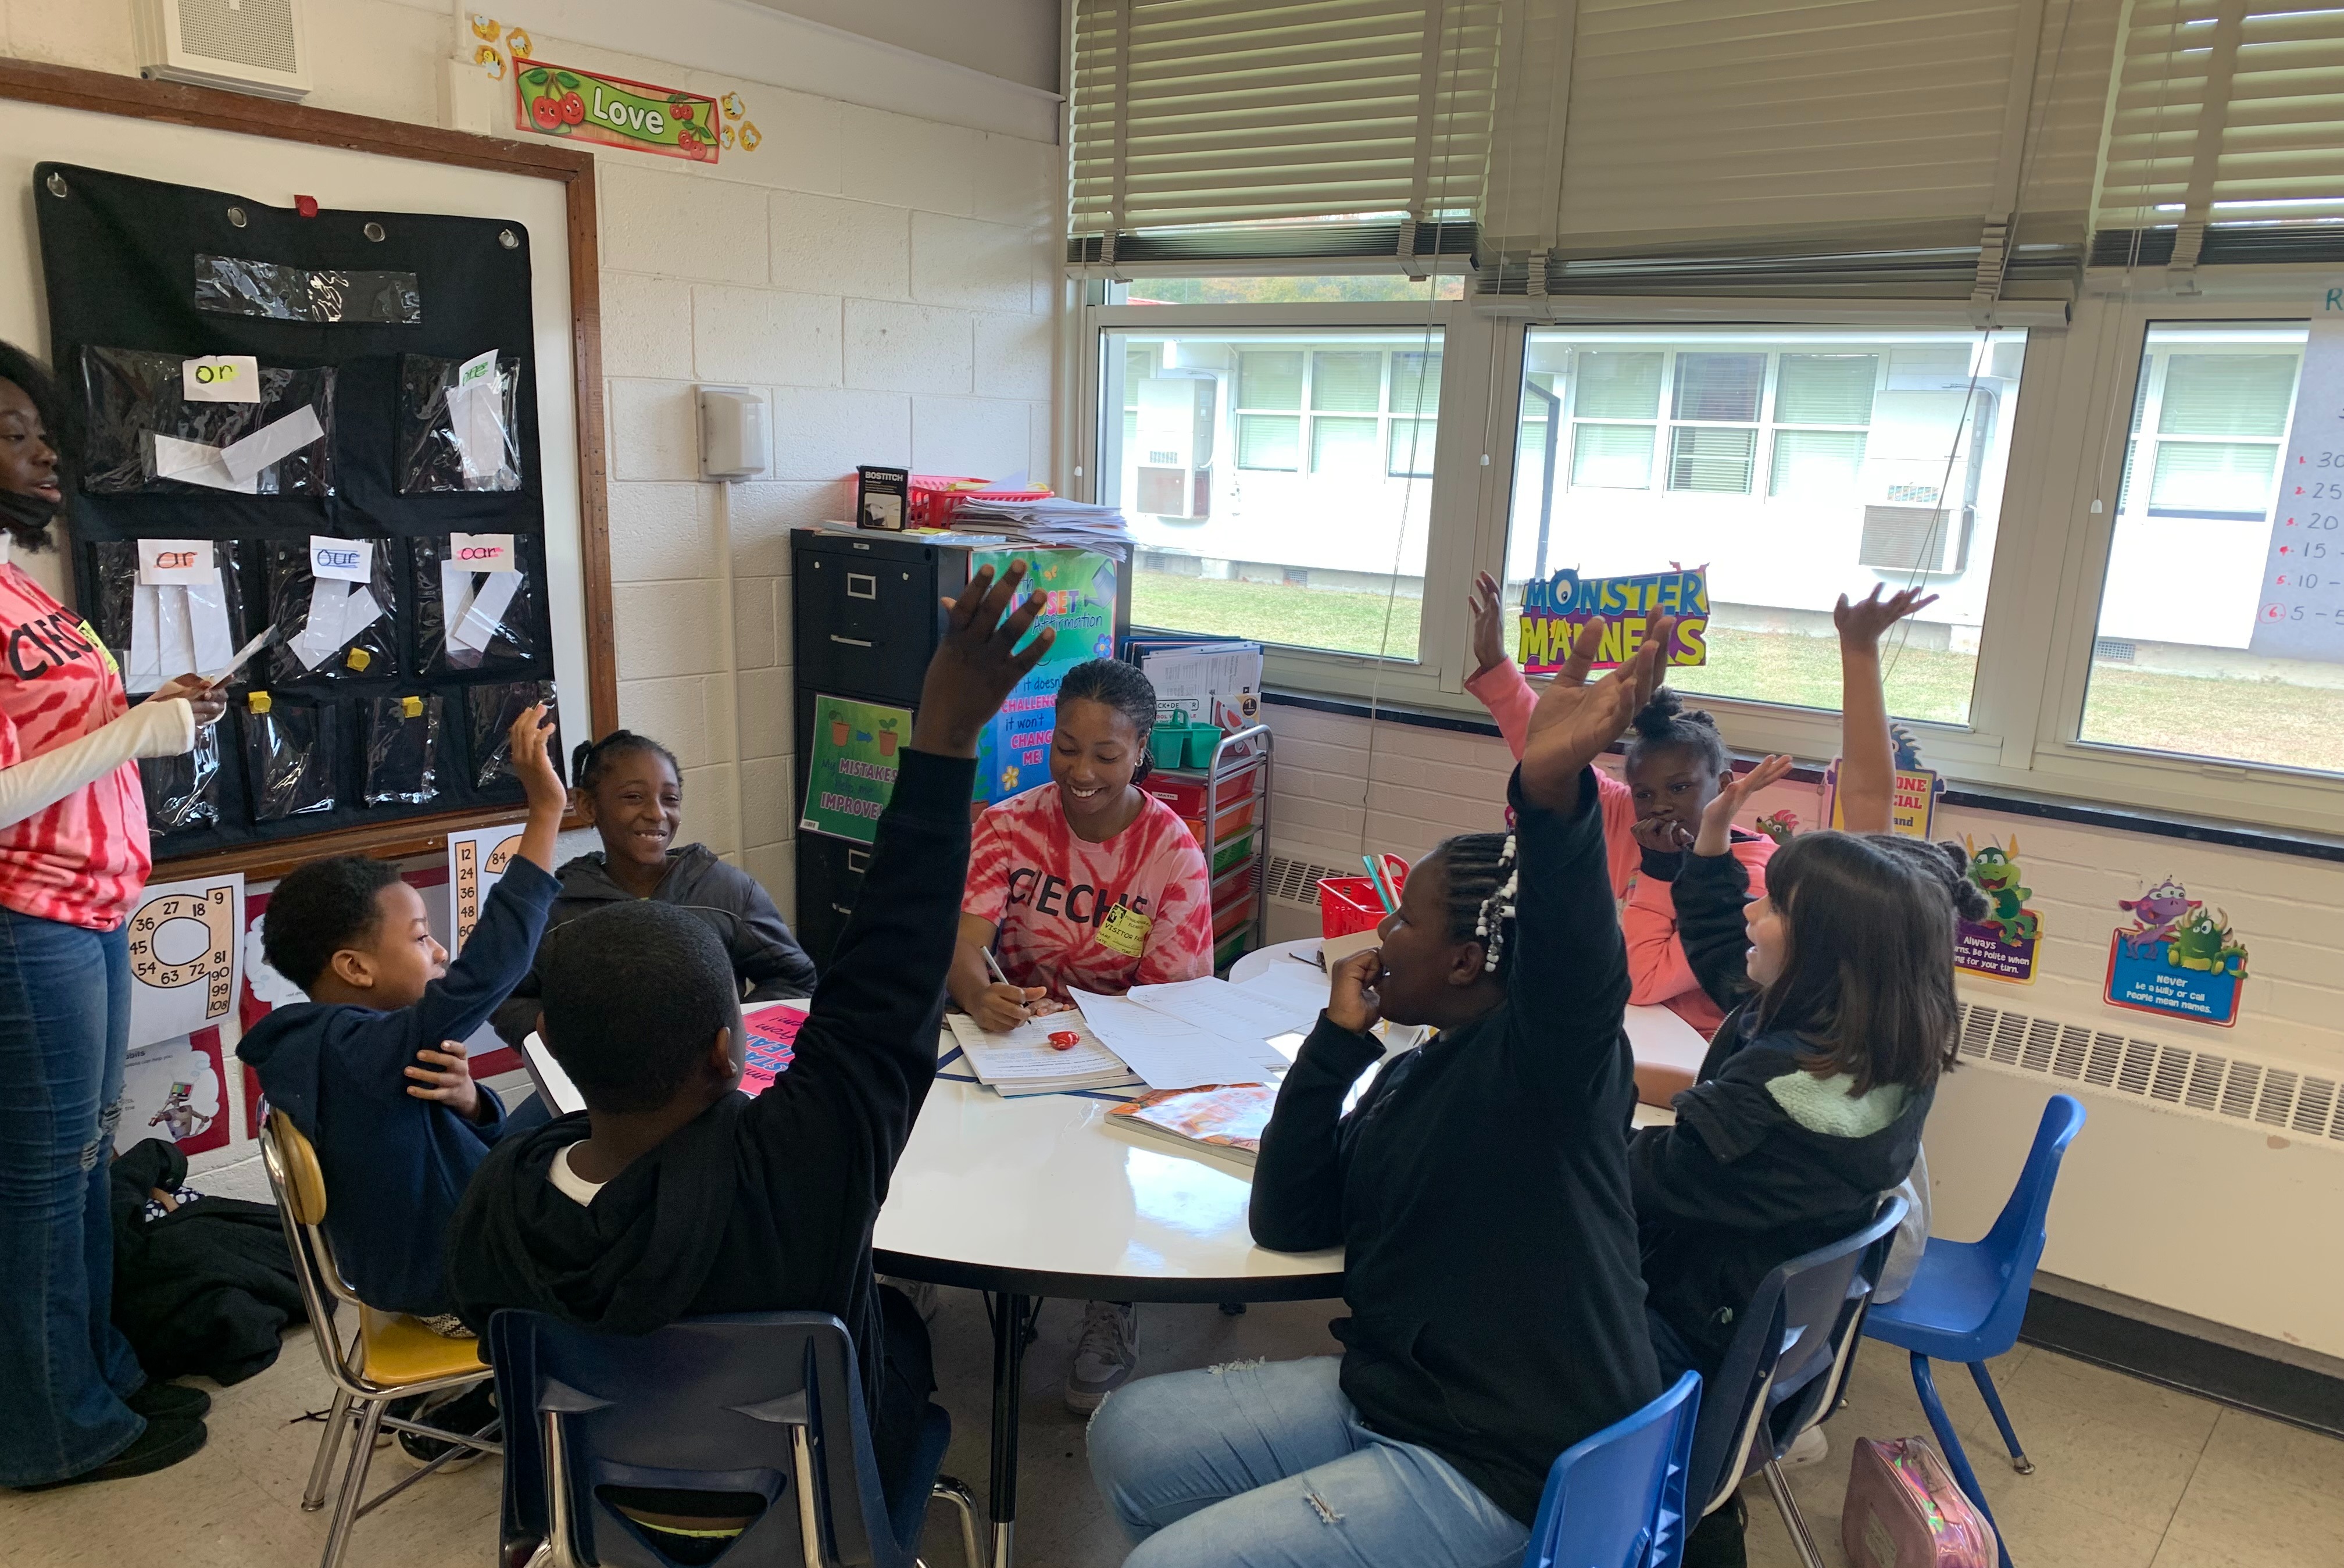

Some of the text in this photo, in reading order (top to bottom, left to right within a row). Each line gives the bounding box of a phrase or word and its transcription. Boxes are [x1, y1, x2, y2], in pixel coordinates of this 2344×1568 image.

[593, 86, 664, 134] Love
[865, 472, 903, 482] BOSTITCH
[2313, 483, 2342, 499] 25
[2307, 513, 2338, 530] 20
[462, 548, 495, 560] oar
[2304, 542, 2326, 558] 15
[156, 552, 196, 569] ar
[2299, 573, 2318, 588] 10
[1524, 568, 1707, 616] MONSTER
[2291, 606, 2304, 621] 5
[1032, 614, 1102, 634] Affirmation
[1518, 616, 1706, 666] MANES
[1024, 678, 1032, 692] it
[1006, 713, 1044, 731] it won't
[1023, 749, 1044, 766] ME!
[839, 758, 898, 784] MISTAKES
[820, 791, 883, 820] IMPROVE!
[461, 849, 471, 860] 12
[492, 852, 506, 865] 84
[460, 867, 473, 880] 24
[215, 892, 224, 904] 9
[460, 887, 474, 899] 36
[163, 901, 179, 915] 27
[192, 903, 206, 917] 18
[460, 906, 474, 918] 48
[136, 917, 155, 931] 36
[1105, 923, 1133, 940] VISITOR
[130, 940, 147, 955] 45
[1964, 936, 1996, 949] Always
[214, 951, 226, 963] 81
[1973, 948, 1982, 956] Be
[2008, 956, 2030, 966] when
[138, 962, 156, 976] 54
[189, 963, 205, 976] 72
[1967, 957, 1979, 965] for
[1981, 960, 1998, 970] your
[2000, 963, 2019, 973] turn.
[161, 970, 179, 984] 63
[212, 966, 230, 981] 90
[2157, 975, 2188, 987] Never
[212, 983, 228, 996] 99
[2135, 982, 2146, 990] be
[2155, 985, 2174, 996] bully
[209, 1000, 228, 1011] 108
[2156, 997, 2179, 1007] mean
[2181, 1002, 2212, 1013] names.
[755, 1024, 795, 1039] from
